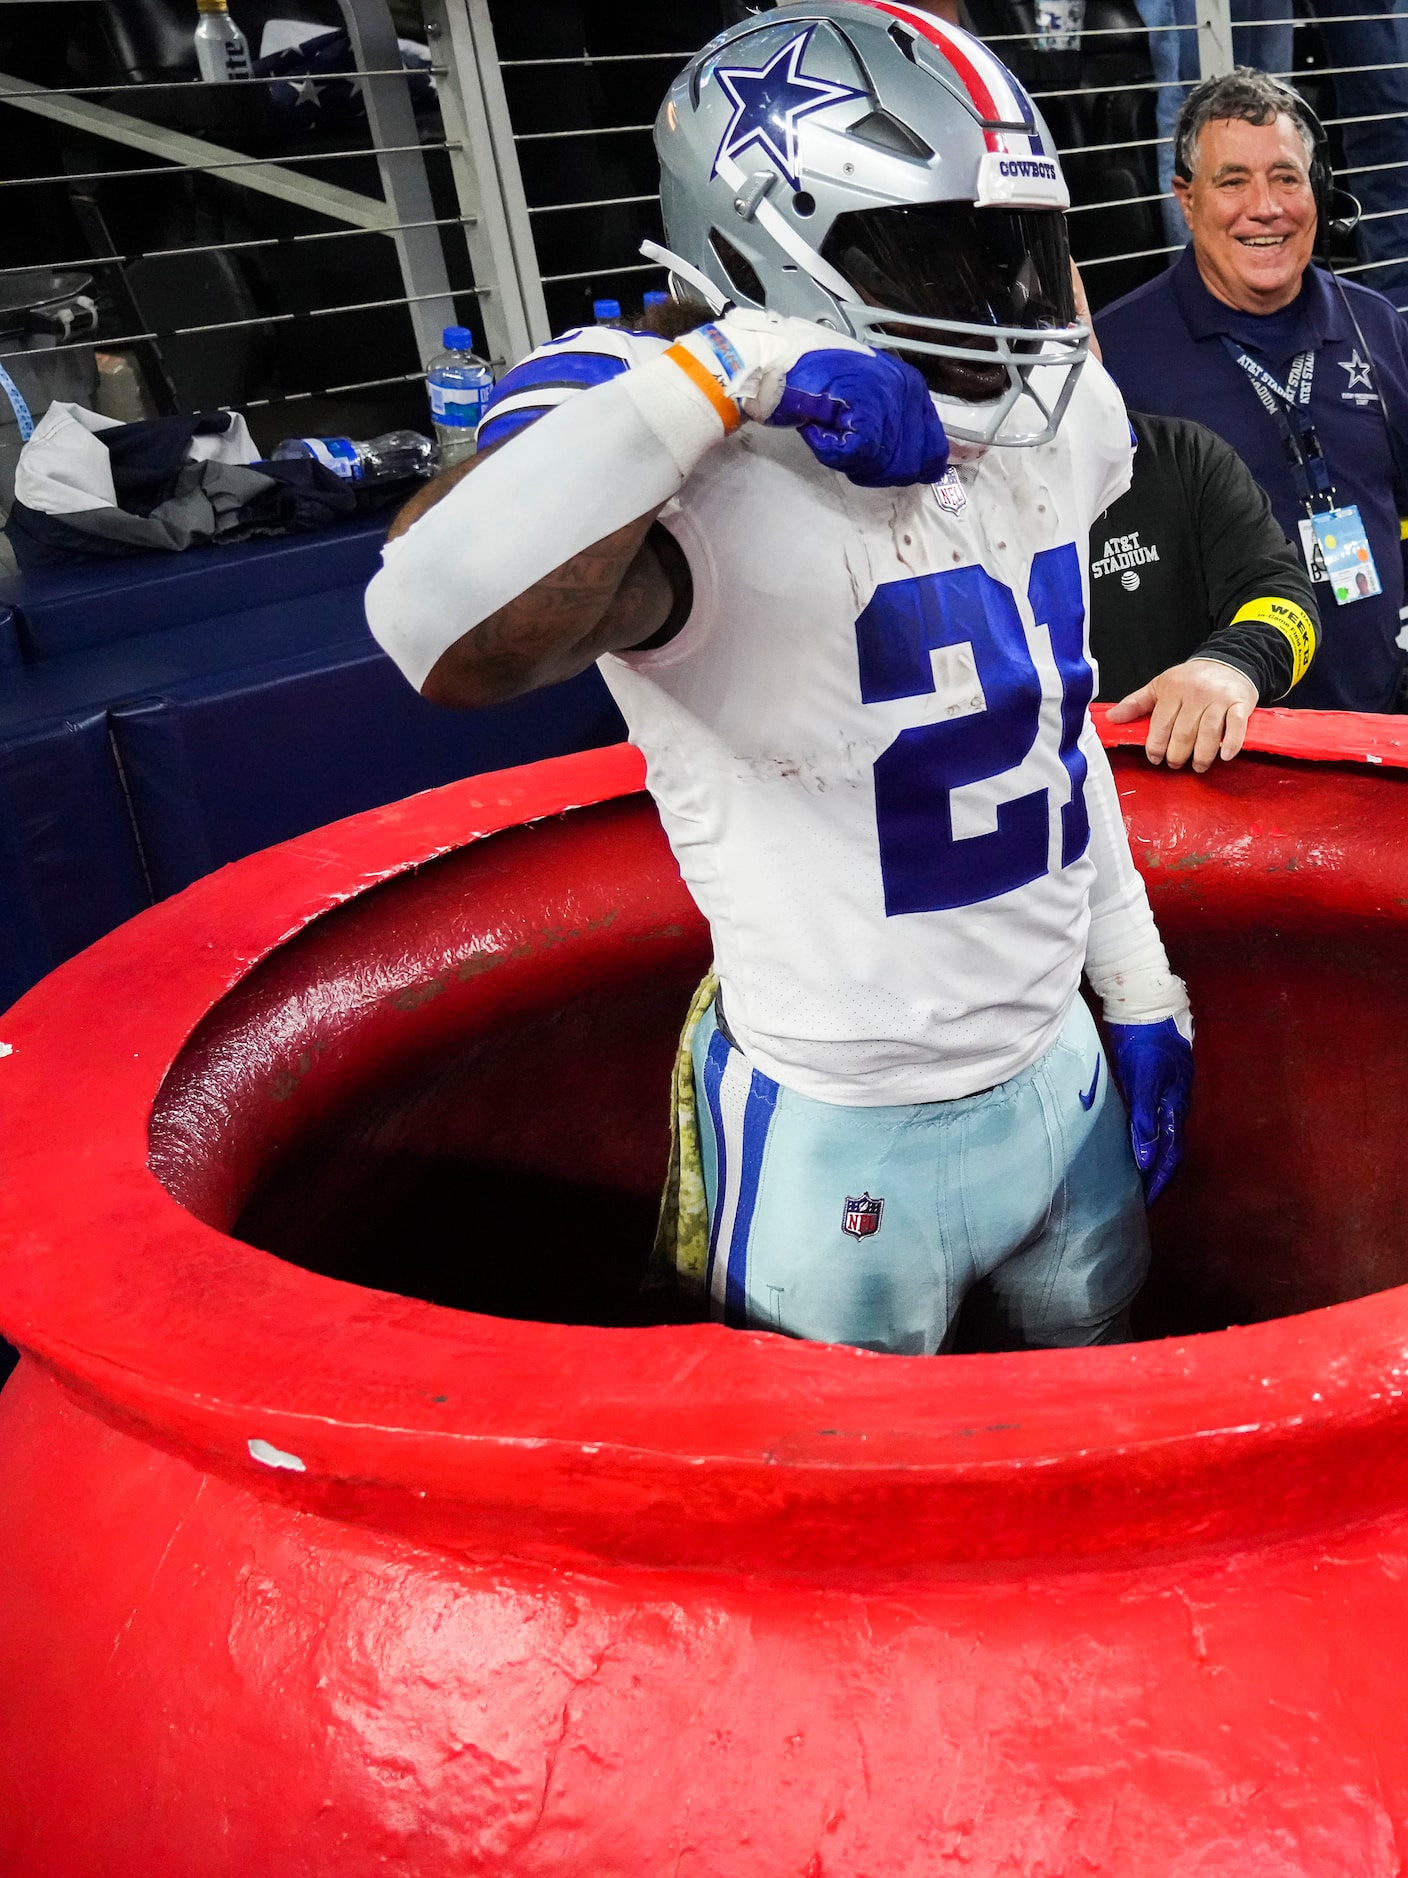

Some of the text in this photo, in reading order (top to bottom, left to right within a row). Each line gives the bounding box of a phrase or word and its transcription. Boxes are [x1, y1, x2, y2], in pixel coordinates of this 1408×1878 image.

[225, 41, 250, 80] ite
[999, 160, 1057, 180] COWBOYS
[1237, 354, 1264, 377] AT&T
[1250, 378, 1278, 415] ADIUM
[1300, 380, 1312, 404] AT&T
[940, 486, 964, 506] NFL
[1103, 531, 1140, 558] AT&T
[1091, 545, 1160, 579] STADIUM
[1271, 604, 1309, 647] WEEK
[855, 541, 1094, 917] 21
[847, 1213, 875, 1232] NFL
